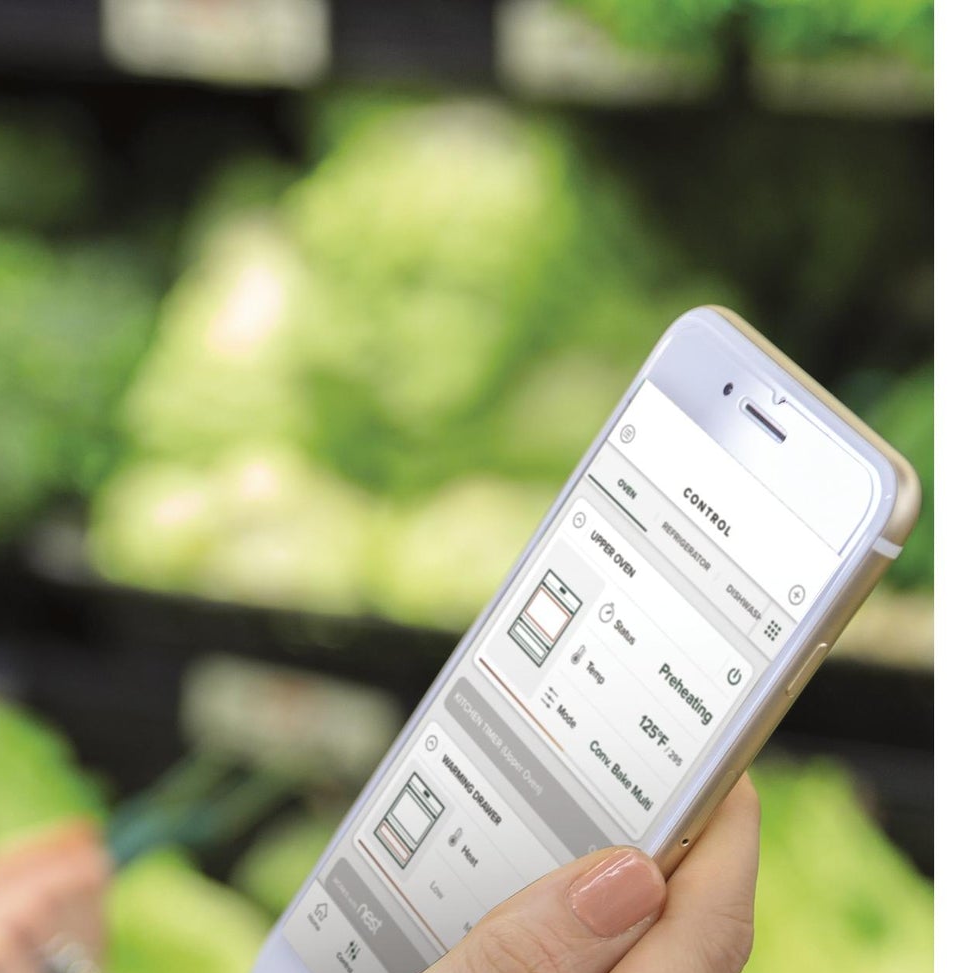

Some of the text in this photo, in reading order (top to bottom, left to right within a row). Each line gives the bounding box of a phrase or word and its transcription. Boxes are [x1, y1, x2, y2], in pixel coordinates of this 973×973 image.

[617, 478, 637, 500] OVEN
[683, 487, 731, 537] CONTROL
[590, 530, 636, 579] UPPER OVEN
[661, 521, 711, 572] REFRIGERATOR
[614, 619, 636, 646] Status
[586, 661, 605, 685] Temp
[659, 663, 713, 726] Preheating
[454, 692, 484, 727] KITCHEN
[482, 722, 503, 749] TIMER
[557, 704, 577, 729] Mode
[442, 754, 502, 826] WARMING DRAWER
[590, 740, 654, 811] Conv. Bake Multi
[461, 845, 478, 868] Heat
[429, 880, 444, 899] Low
[356, 903, 383, 935] nest
[336, 952, 353, 973] Control
